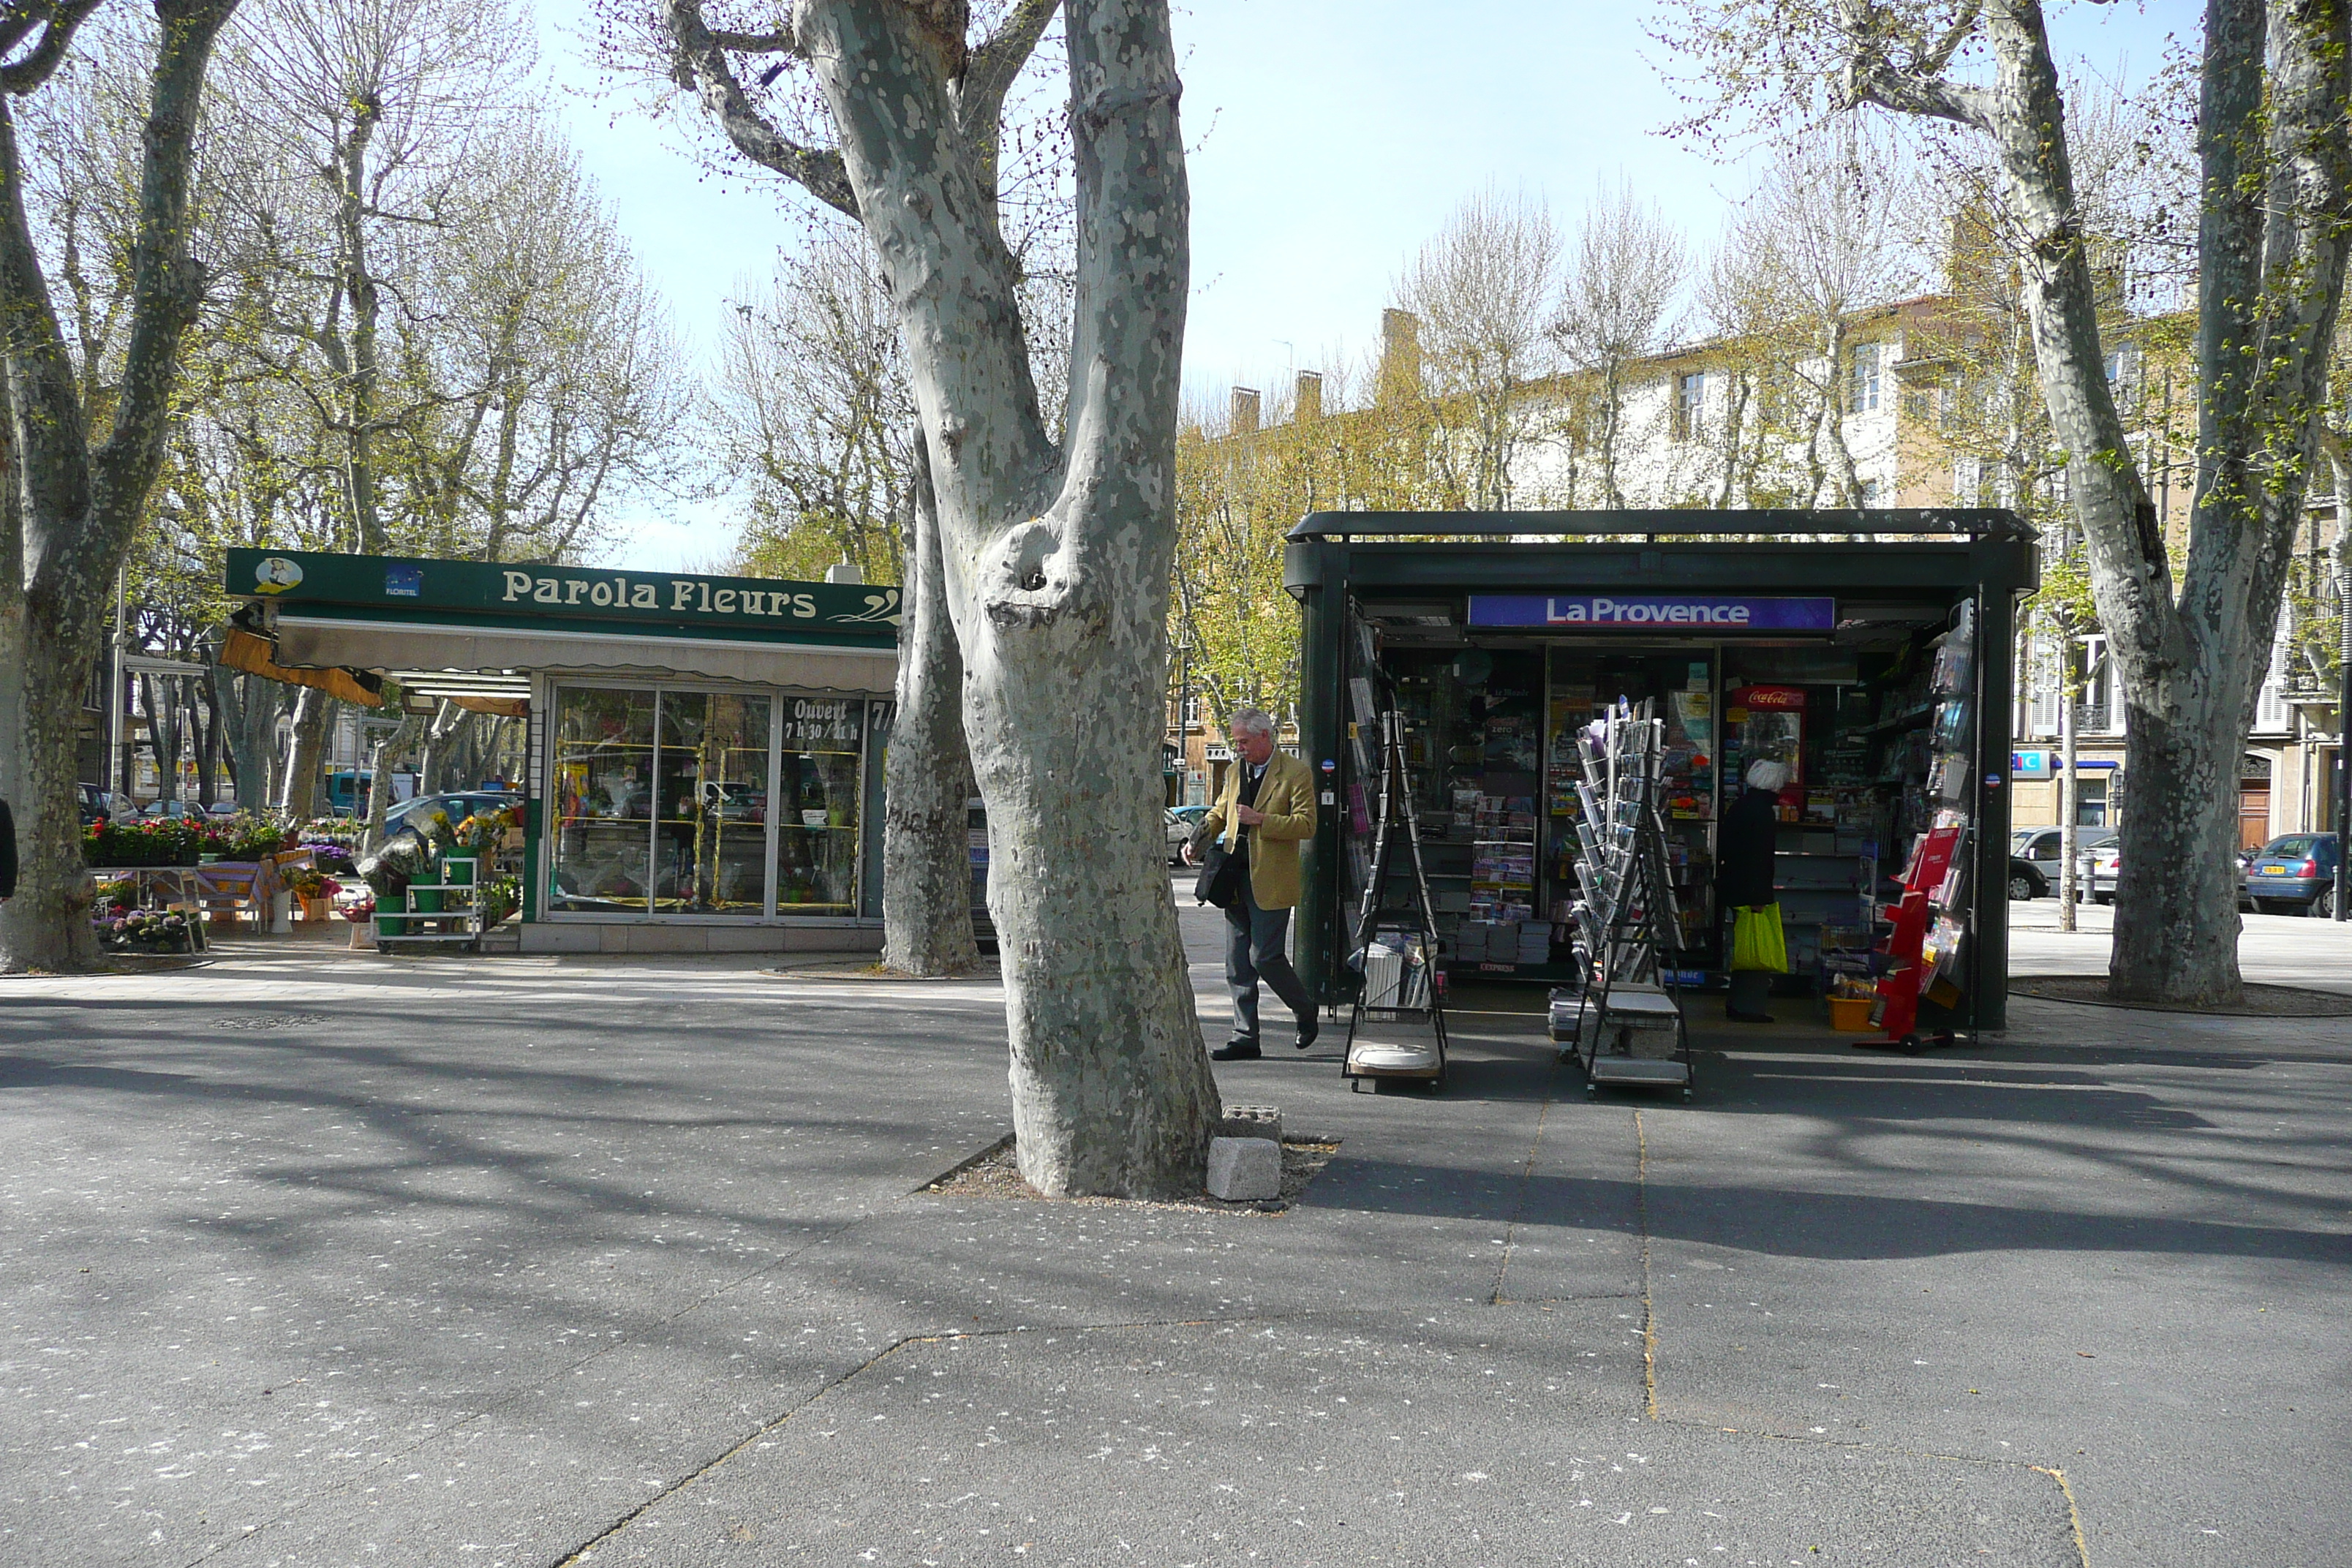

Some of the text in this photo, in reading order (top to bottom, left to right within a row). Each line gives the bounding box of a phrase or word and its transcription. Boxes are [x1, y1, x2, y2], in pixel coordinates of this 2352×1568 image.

[385, 587, 418, 596] FLORITEL
[502, 570, 817, 619] Parola Fleurs
[1546, 598, 1750, 623] La Provence
[794, 698, 848, 720] Ouvert
[1492, 725, 1512, 734] zero
